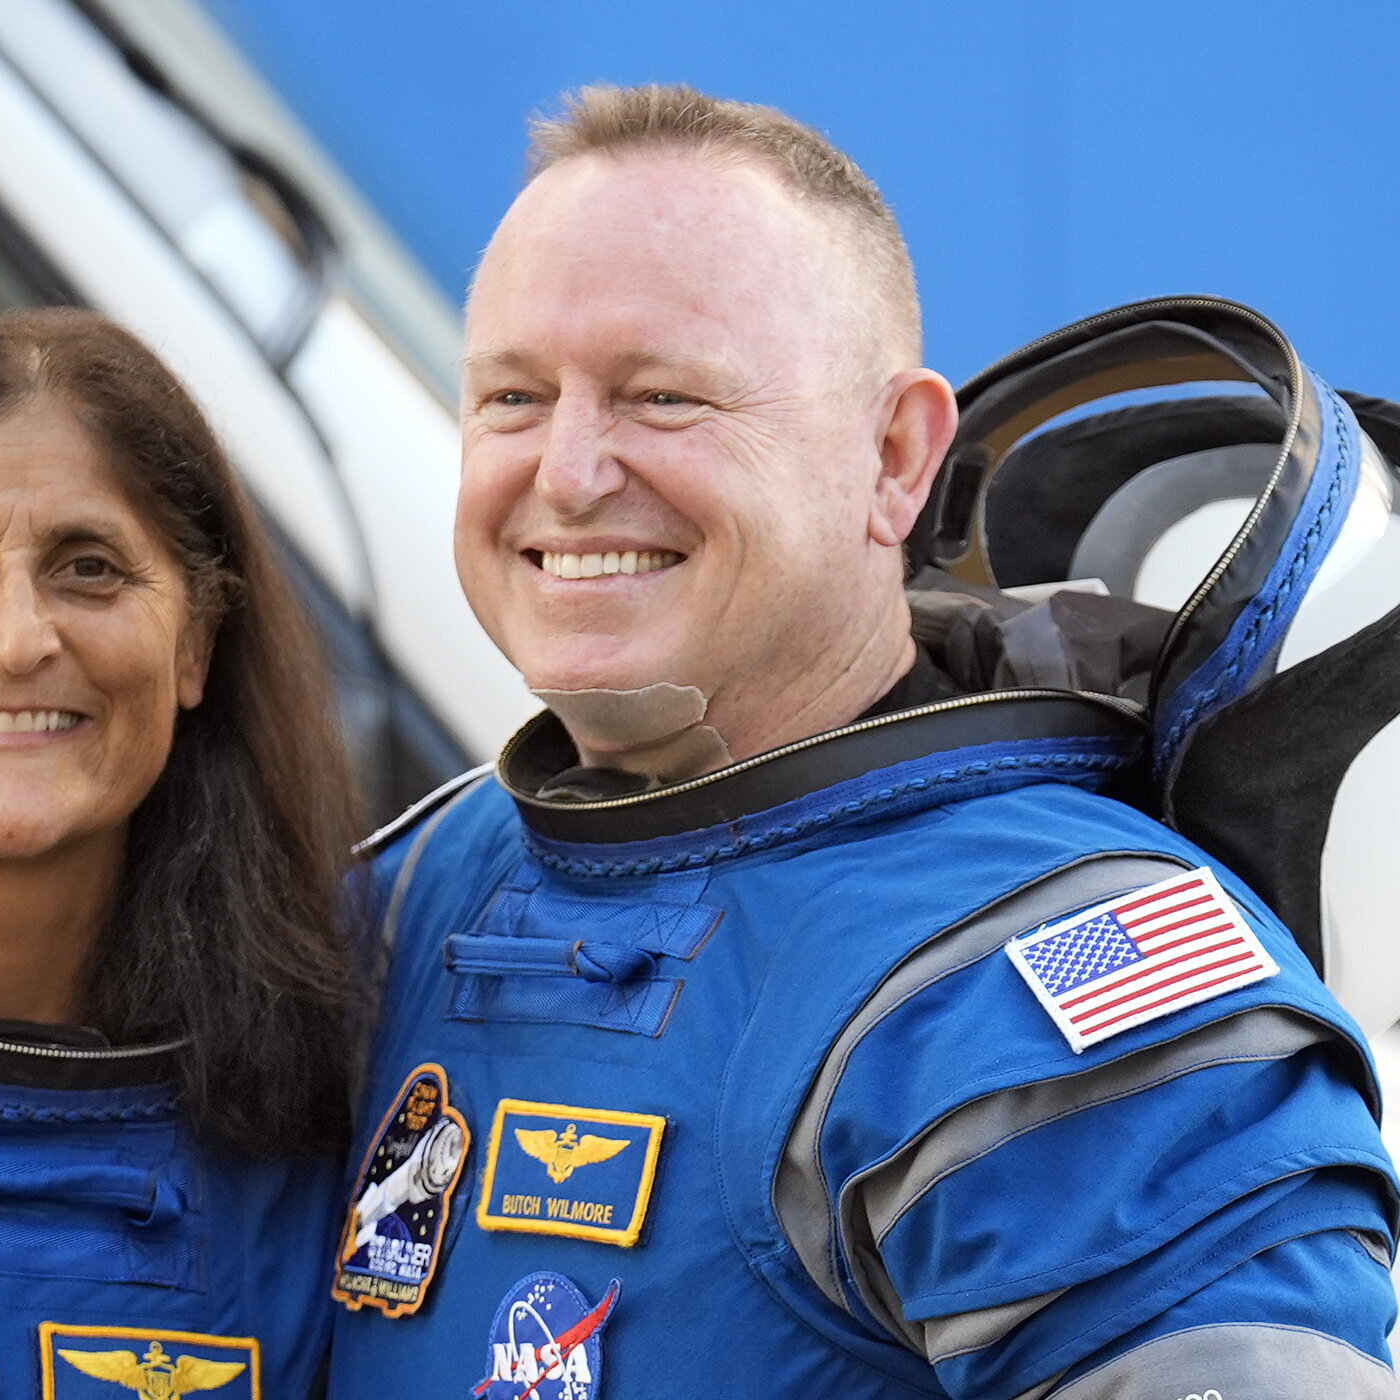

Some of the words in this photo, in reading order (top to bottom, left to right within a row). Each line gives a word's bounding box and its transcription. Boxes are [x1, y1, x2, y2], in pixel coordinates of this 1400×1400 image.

[502, 1194, 541, 1216] BUTCH
[546, 1197, 614, 1225] WILMORE
[491, 1342, 592, 1384] NASA
